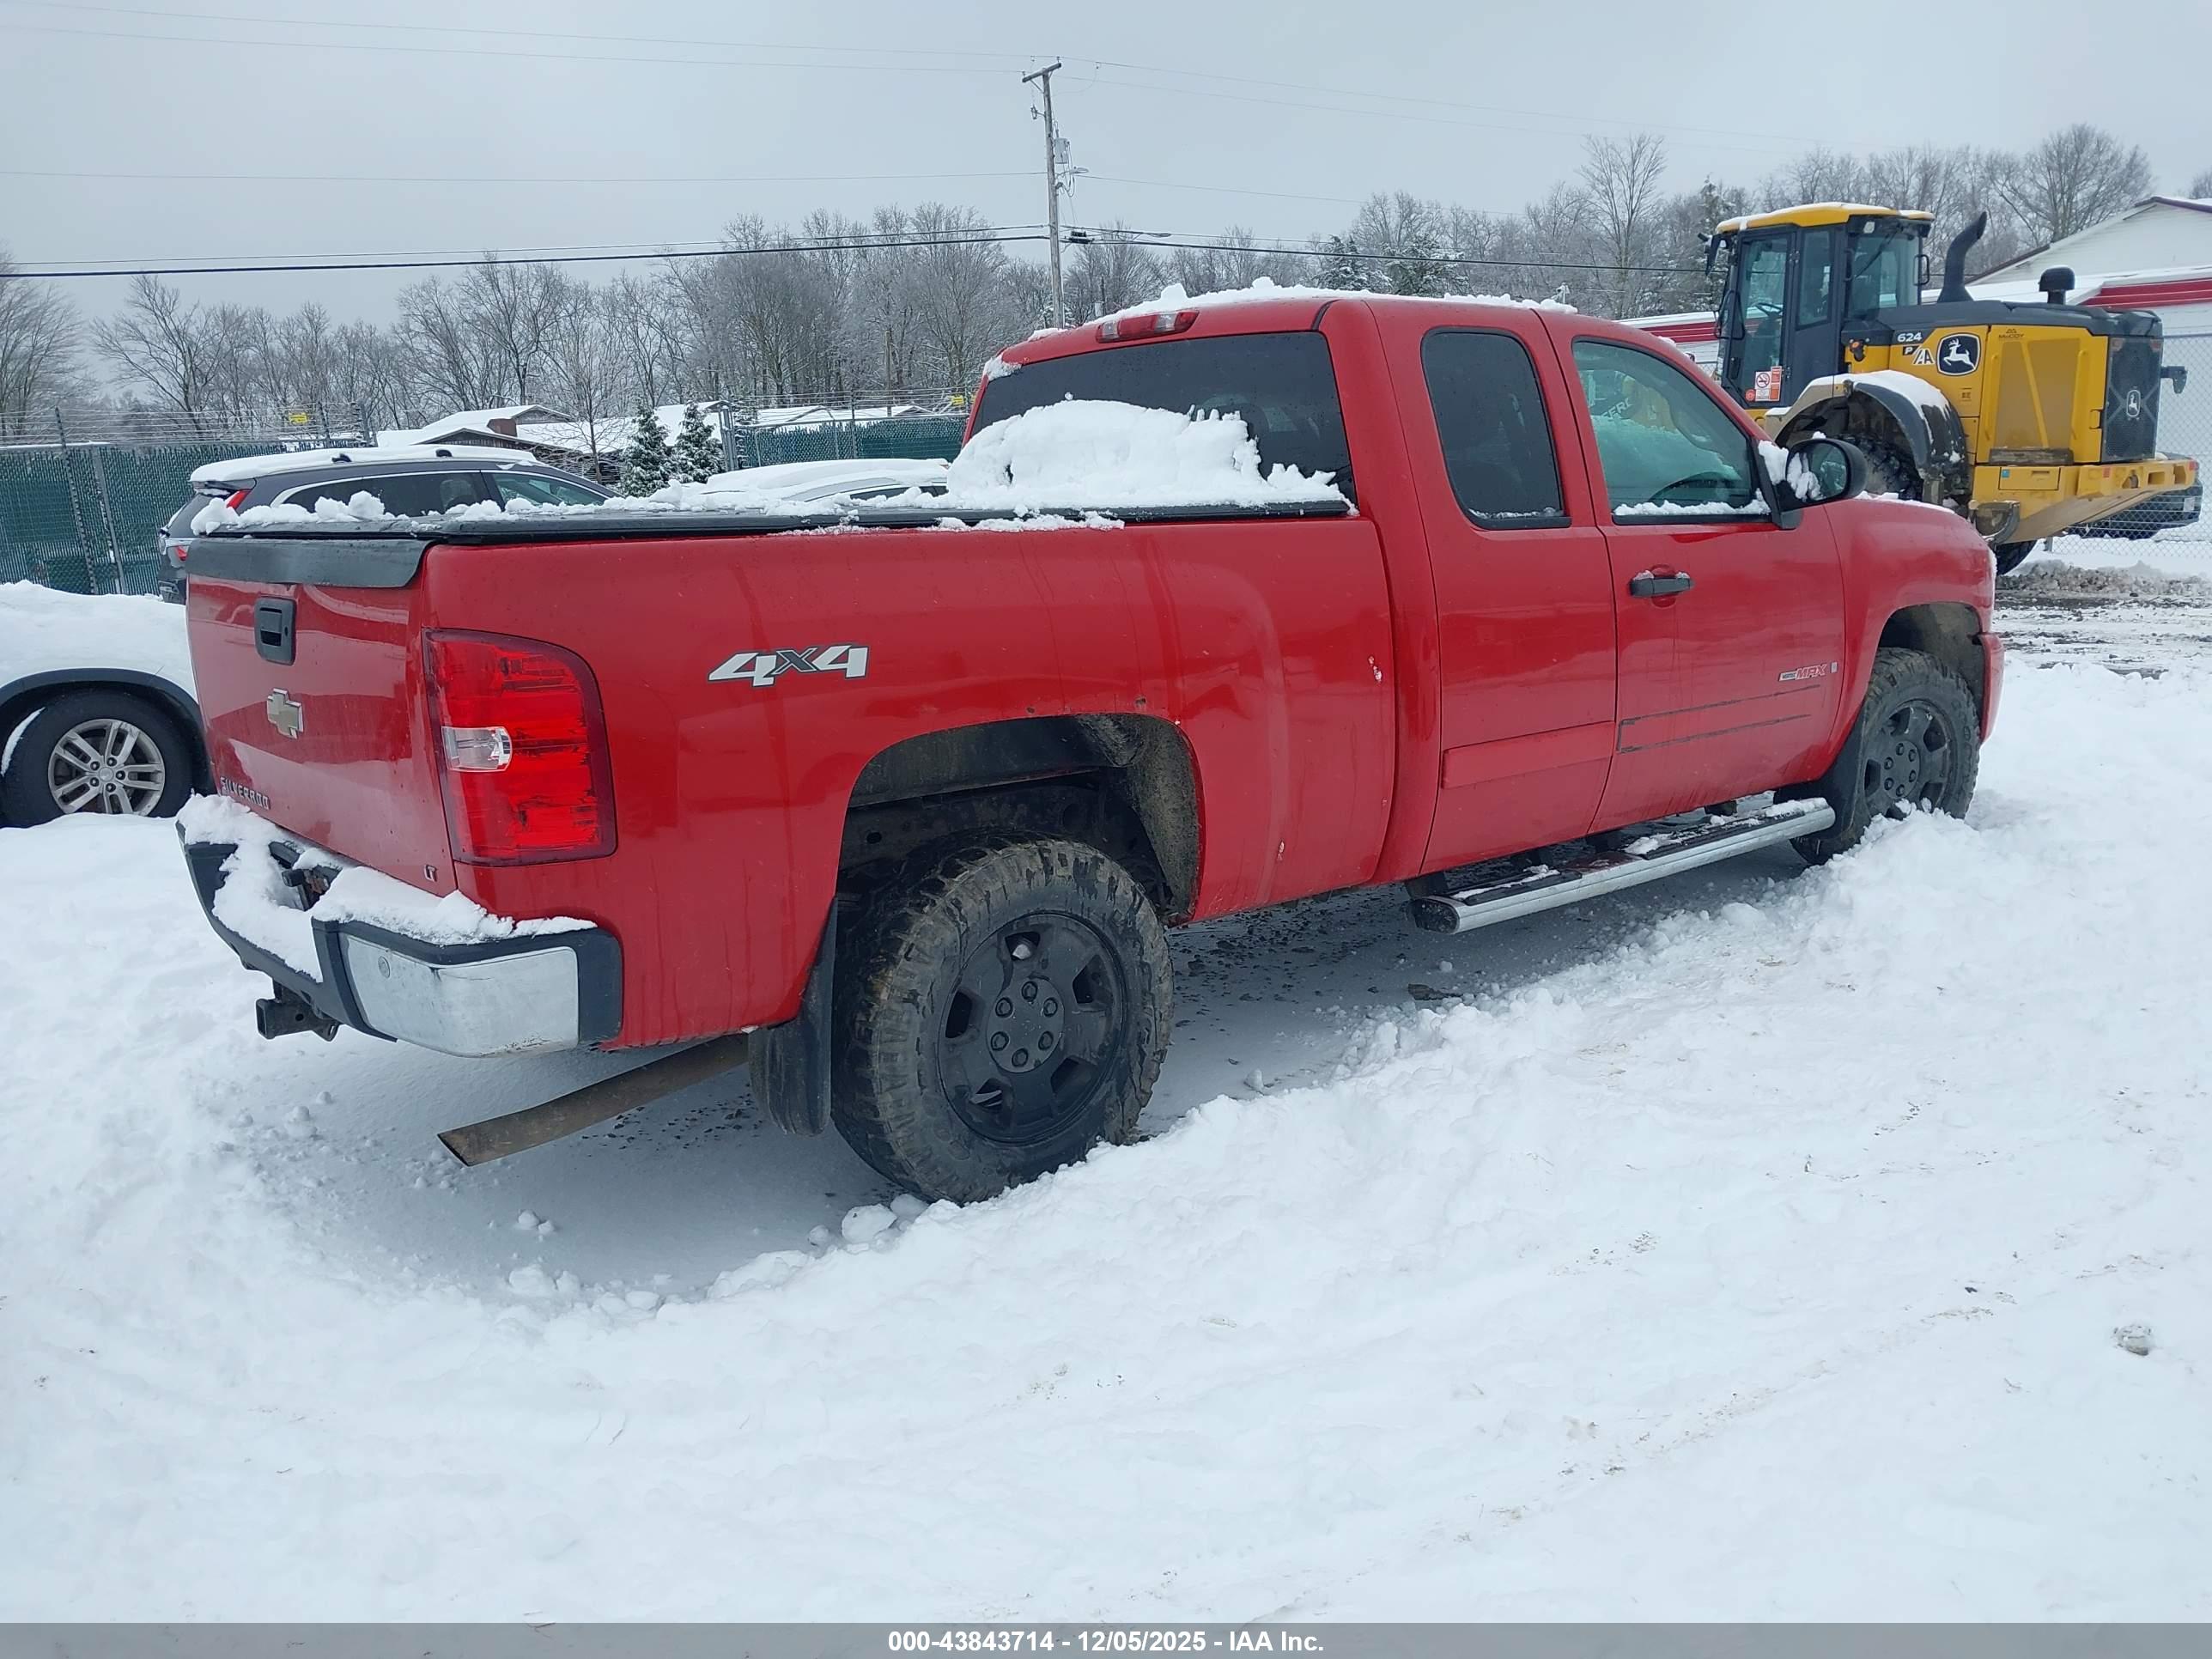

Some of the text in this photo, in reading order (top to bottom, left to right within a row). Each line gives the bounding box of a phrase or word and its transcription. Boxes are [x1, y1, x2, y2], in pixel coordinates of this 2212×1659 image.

[1897, 331, 1923, 343] 624
[1905, 346, 1913, 355] P
[1796, 663, 1827, 680] MAX
[220, 776, 270, 810] SILVERADO
